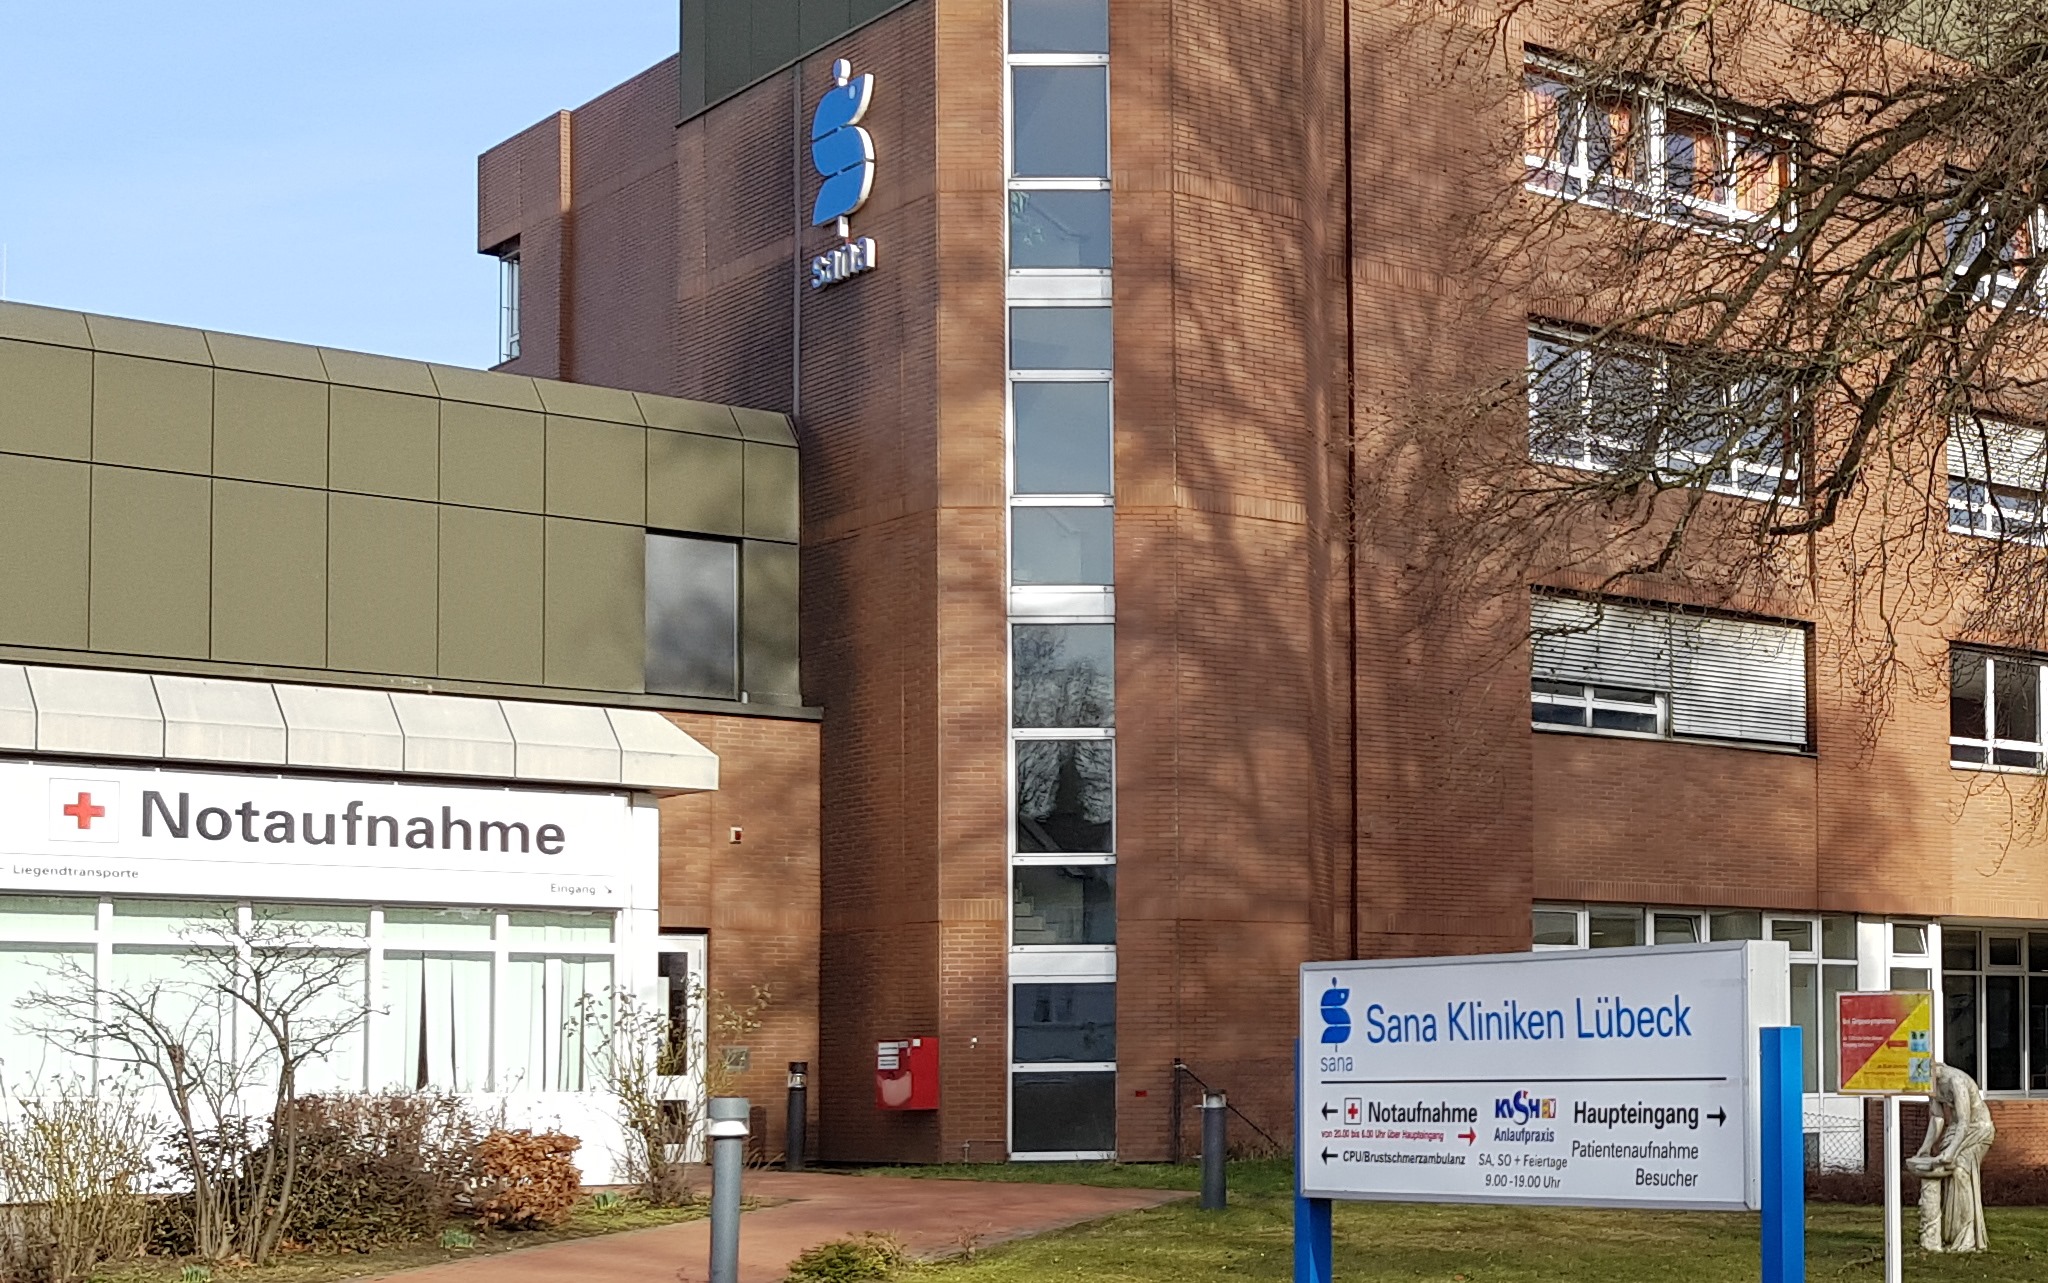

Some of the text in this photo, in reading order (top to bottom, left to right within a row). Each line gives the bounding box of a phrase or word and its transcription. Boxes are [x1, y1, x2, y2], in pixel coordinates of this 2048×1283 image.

[141, 789, 566, 855] Notaufnahme
[13, 864, 139, 879] Liegendtransporte
[550, 883, 596, 896] Eingang
[1366, 995, 1692, 1043] Sana Kliniken Lübeck
[1320, 1055, 1353, 1073] sana
[1368, 1101, 1478, 1123] Notaufnahme
[1573, 1101, 1699, 1130] Haupteingang
[1375, 1129, 1386, 1139] Uhr
[1494, 1127, 1555, 1145] Anlaufpraxis
[1343, 1150, 1466, 1165] CPU/Brustschmerzambulanz
[1572, 1139, 1699, 1161] Patientenaufnahme
[1497, 1153, 1512, 1167] SO
[1523, 1154, 1568, 1171] Feiertage
[1543, 1176, 1561, 1188] Uhr
[1635, 1167, 1699, 1188] Besucher
